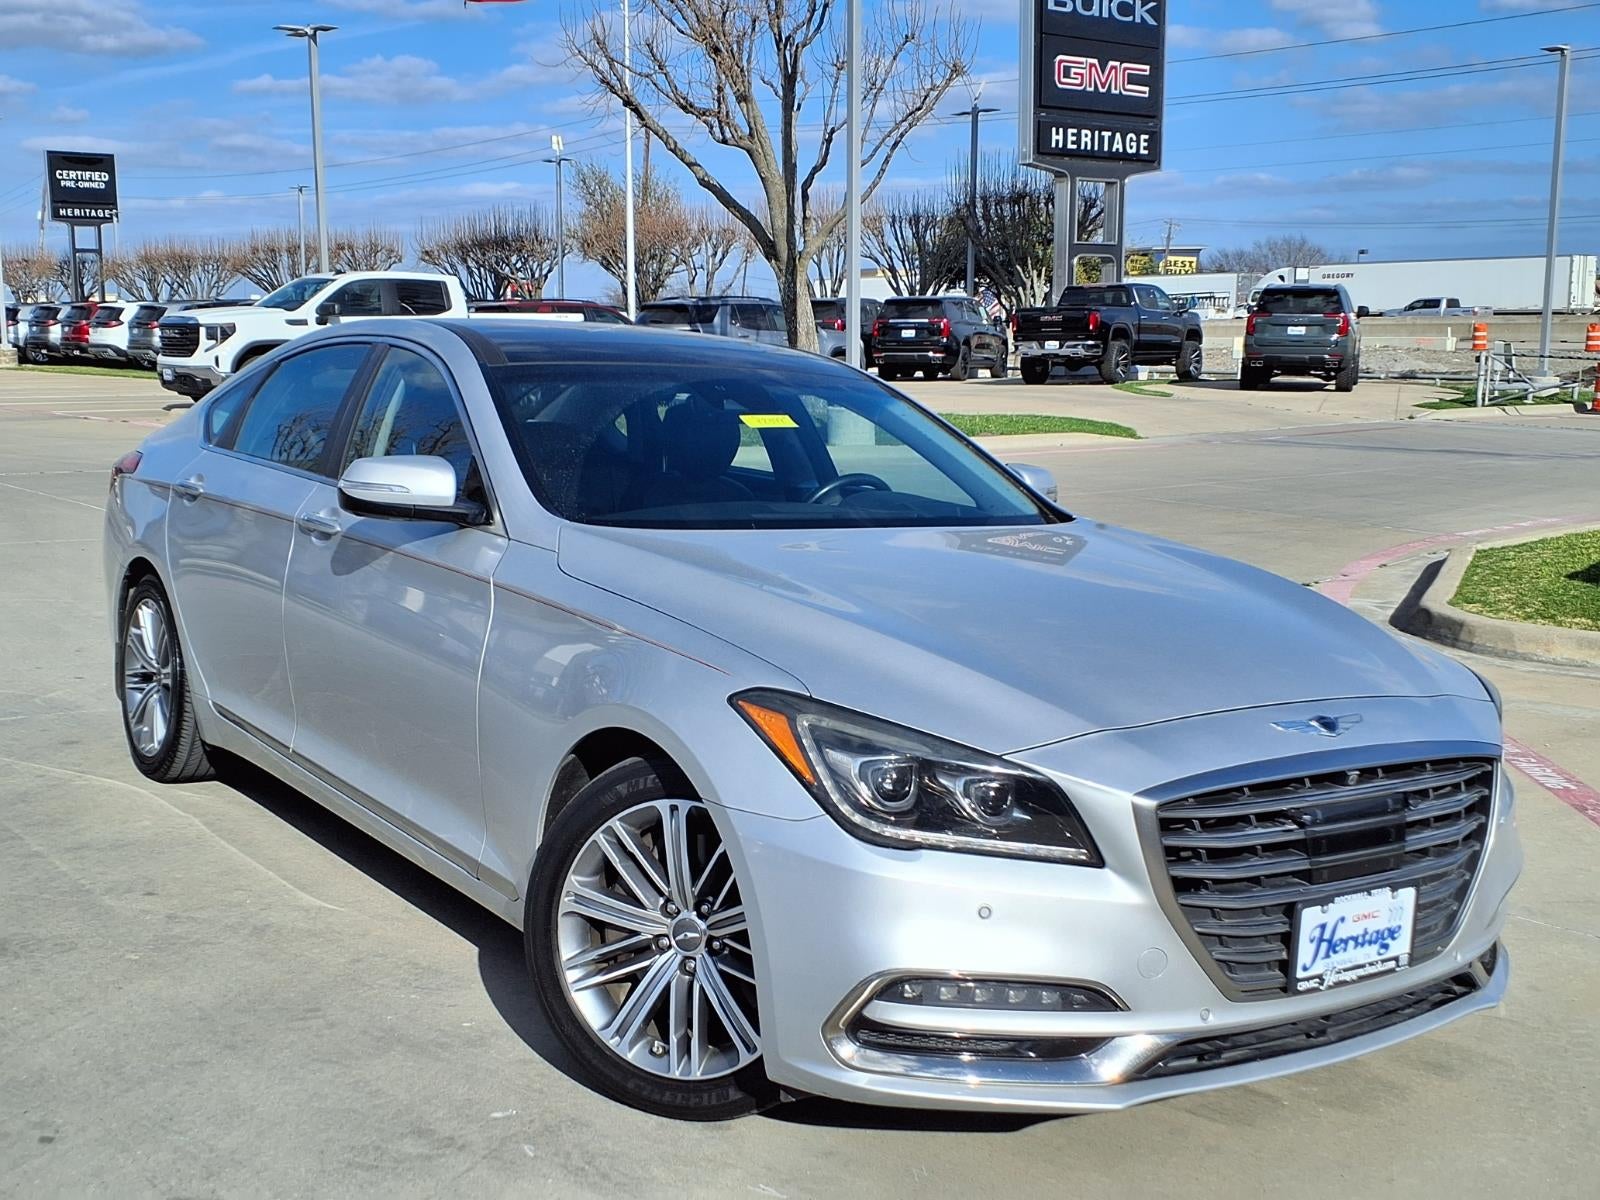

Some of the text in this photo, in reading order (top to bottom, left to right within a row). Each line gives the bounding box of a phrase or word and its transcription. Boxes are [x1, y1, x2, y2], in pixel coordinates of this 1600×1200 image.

[1054, 54, 1150, 97] GMC
[1051, 126, 1149, 155] HERITAGE
[55, 169, 109, 181] CERTIFIED
[60, 180, 105, 189] PRE-OWNED
[59, 208, 111, 217] HERITAGE
[1165, 260, 1194, 268] BEST
[1352, 910, 1380, 923] GMC
[1301, 915, 1402, 973] Heritage
